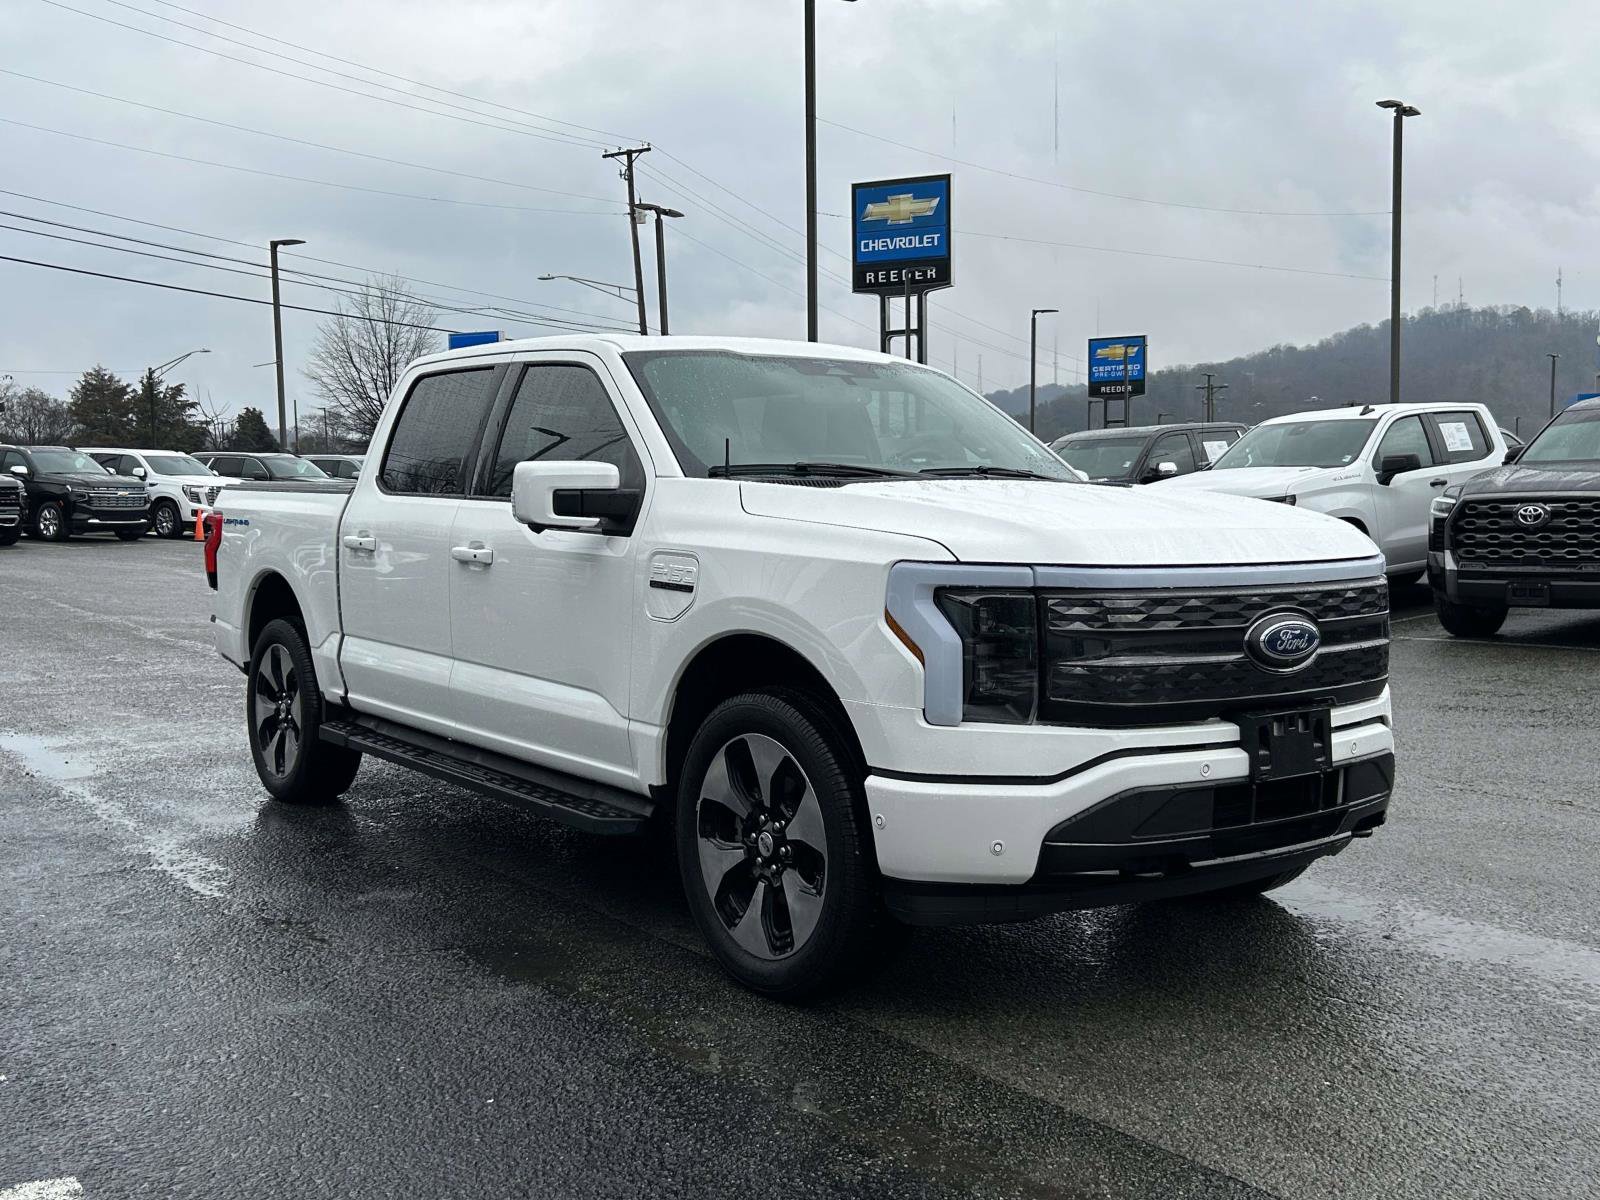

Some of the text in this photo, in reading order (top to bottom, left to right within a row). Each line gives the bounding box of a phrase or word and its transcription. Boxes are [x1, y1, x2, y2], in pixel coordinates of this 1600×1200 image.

[860, 234, 940, 252] CHEVROLET
[1092, 364, 1141, 372] CERTIFED
[1100, 385, 1132, 393] REEDER
[1276, 629, 1309, 651] Ford
